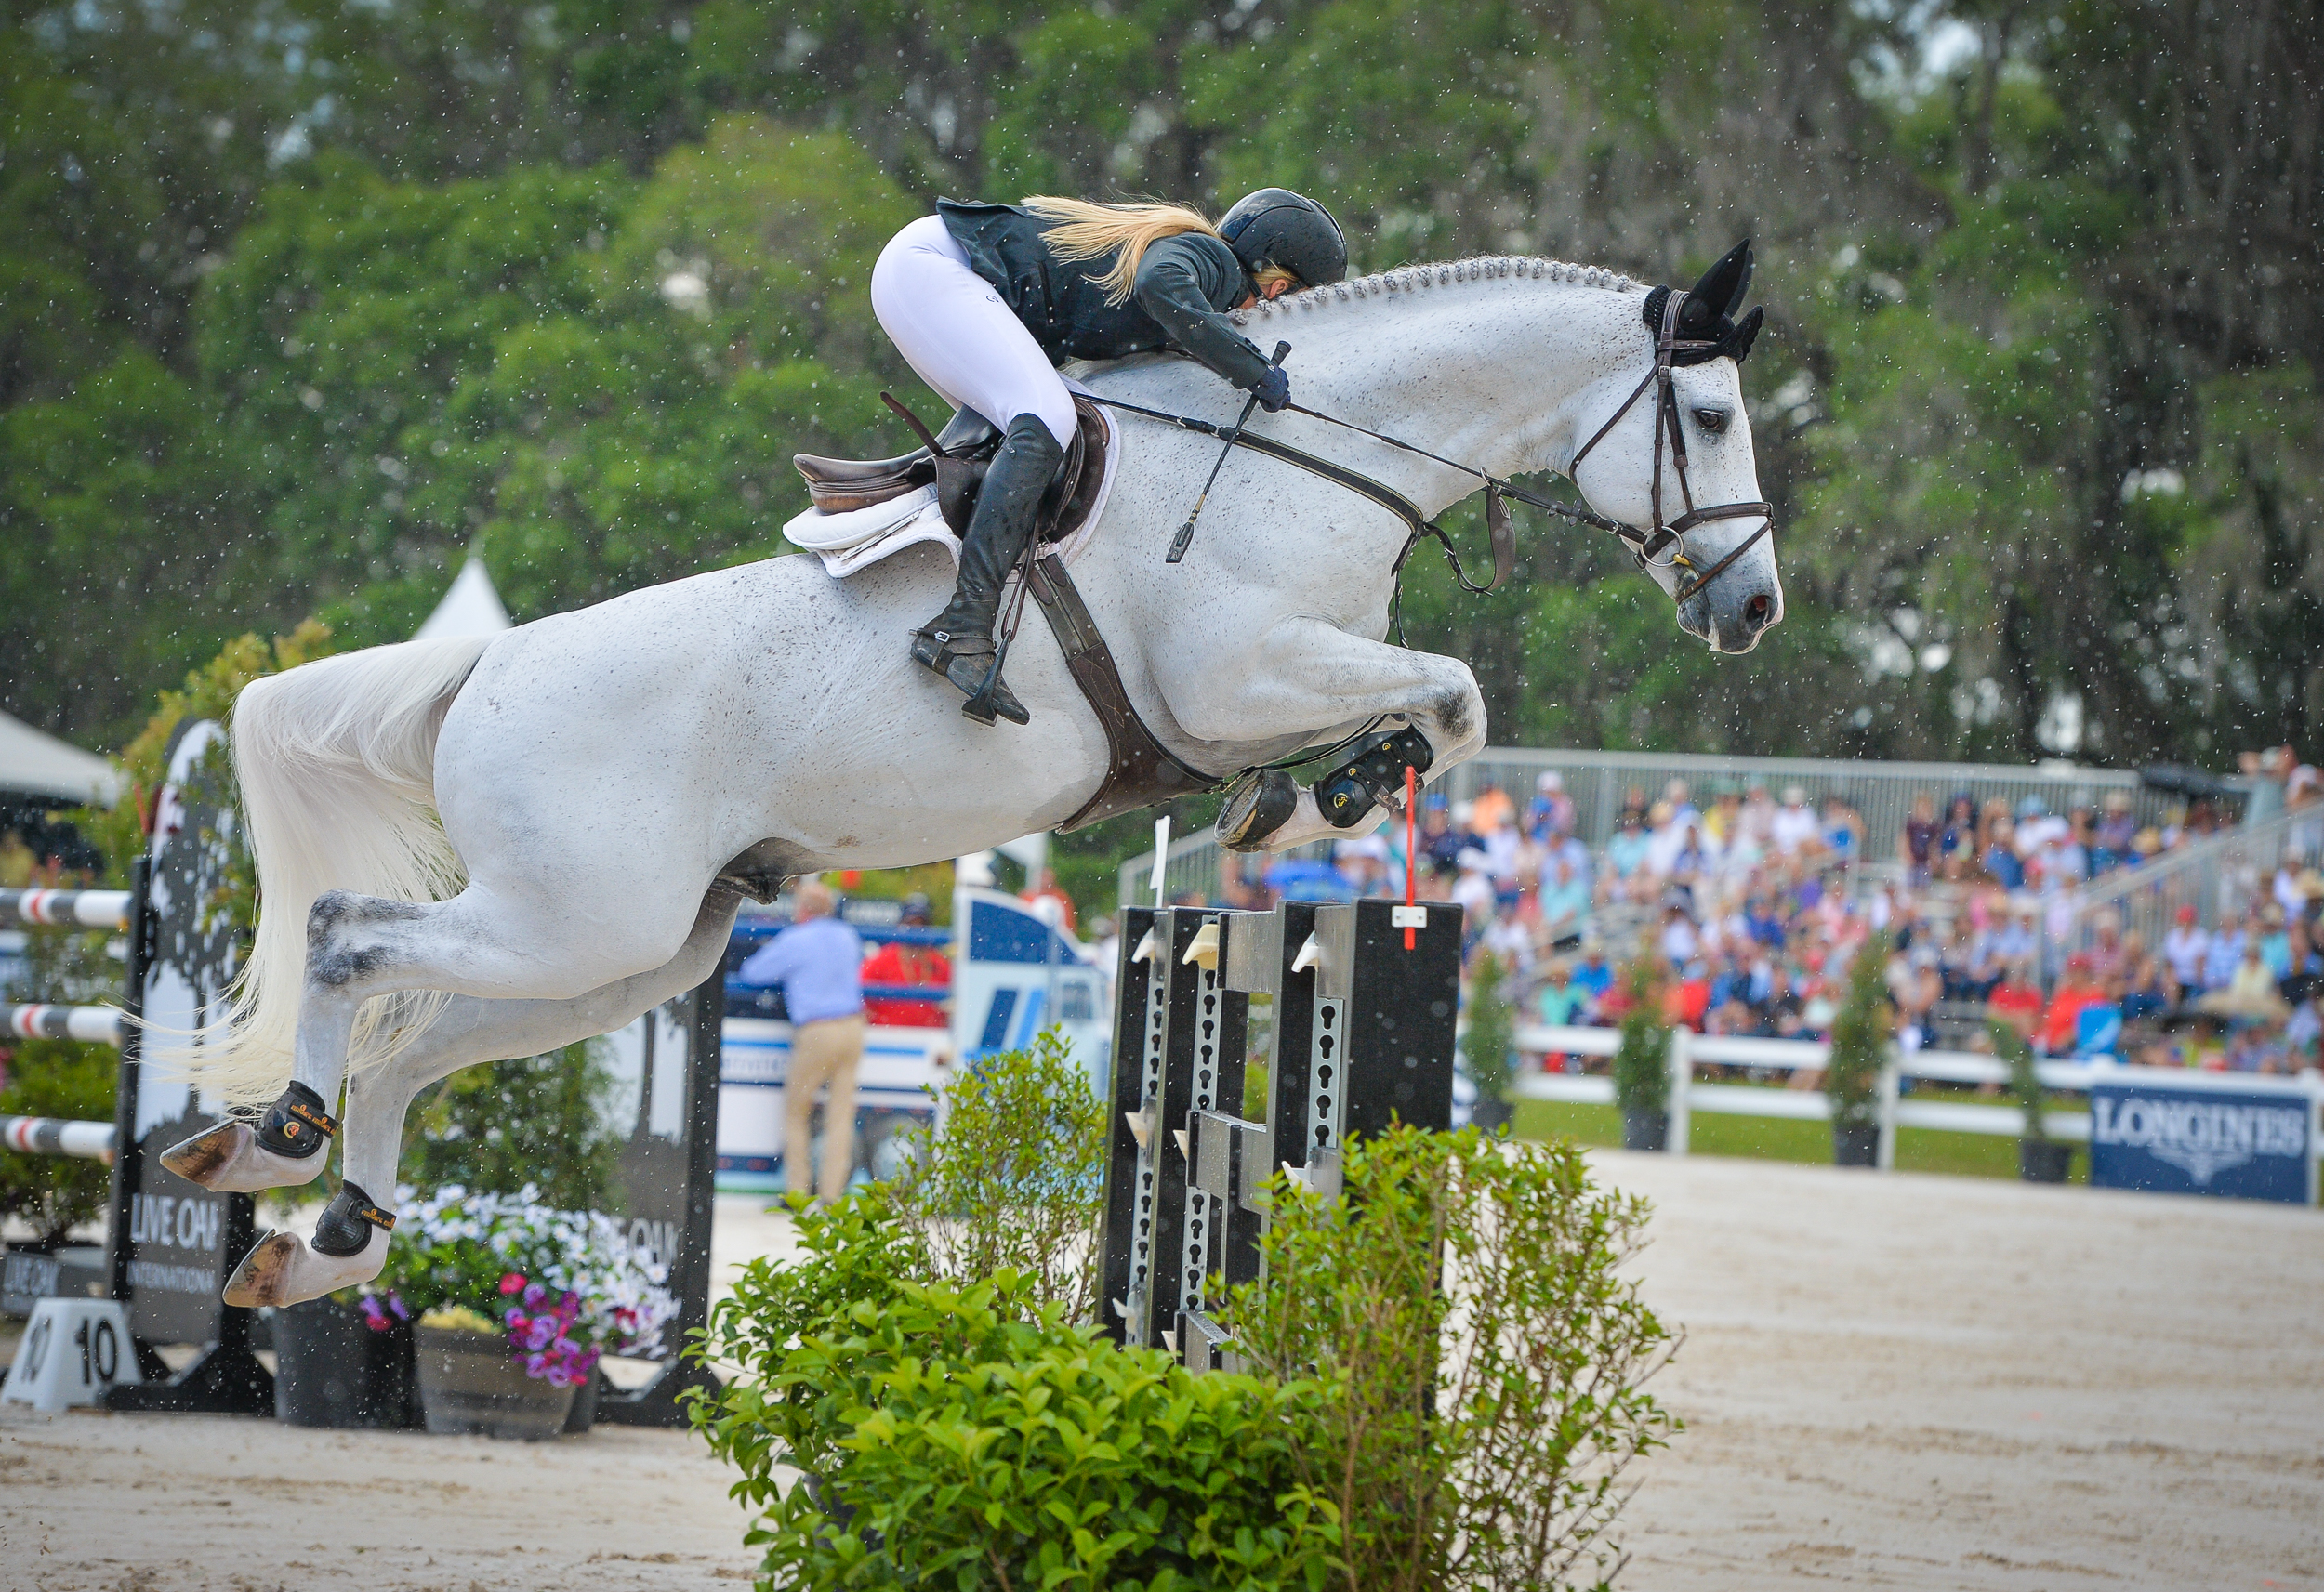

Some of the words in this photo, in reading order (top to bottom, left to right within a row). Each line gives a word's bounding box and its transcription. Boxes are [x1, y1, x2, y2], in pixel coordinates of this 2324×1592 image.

[2093, 1096, 2305, 1159] LONGINES
[130, 1192, 176, 1246] LIVE
[75, 1318, 117, 1385] 10
